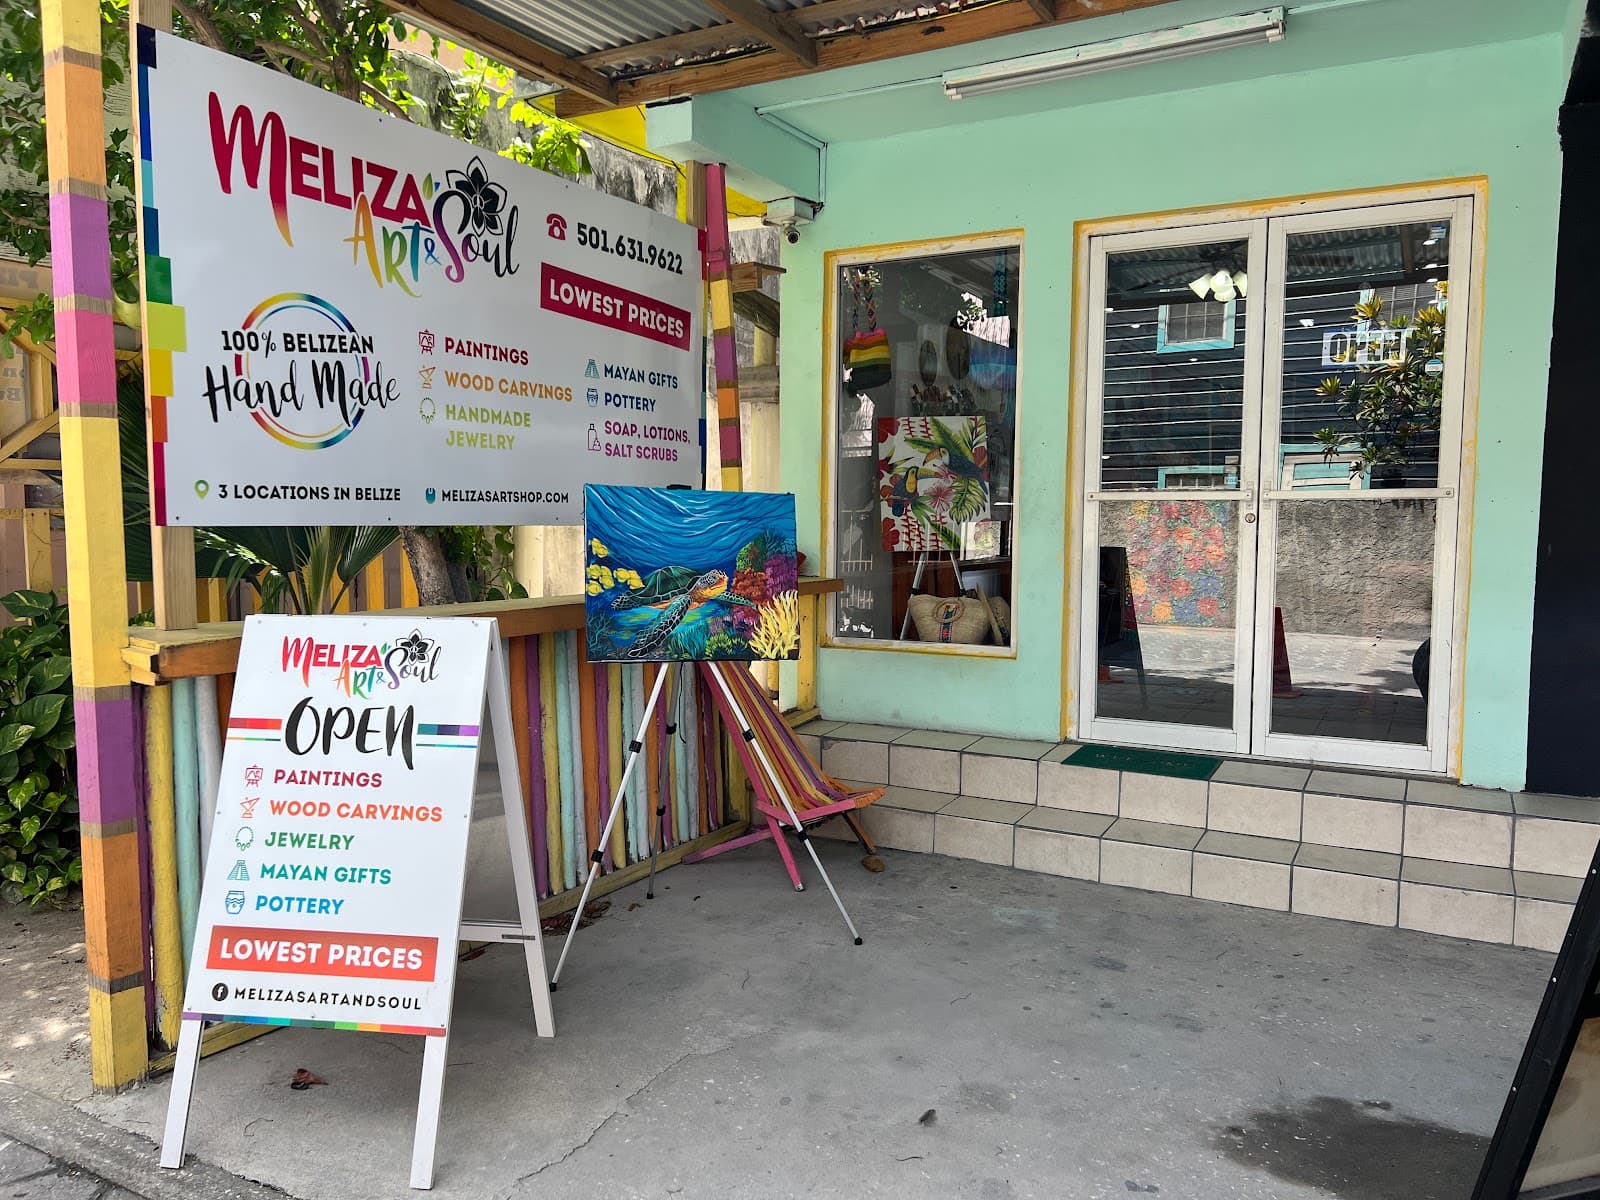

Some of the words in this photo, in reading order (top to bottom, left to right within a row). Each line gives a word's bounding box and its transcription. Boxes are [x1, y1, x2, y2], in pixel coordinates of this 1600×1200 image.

[577, 222, 683, 275] 501.631.9622
[550, 278, 623, 319] LOWEST
[628, 303, 684, 339] PRICES
[221, 330, 276, 358] 100%
[283, 332, 374, 353] BELIZEAN
[444, 336, 529, 366] PAINTINGS
[444, 370, 494, 392] WOOD
[500, 379, 573, 402] CARVINGS
[604, 363, 645, 383] MAYAN
[648, 371, 678, 389] GIFTS
[202, 359, 304, 423] Hand
[312, 359, 400, 428] Made
[604, 392, 656, 412] POTTERY
[445, 404, 531, 428] HANDMADE
[445, 430, 515, 450] JEWELRY
[604, 421, 641, 440] SOAP,
[644, 424, 691, 444] LOTIONS,
[604, 443, 632, 458] SALT
[636, 446, 678, 462] SCRUBS
[218, 484, 228, 499] 3
[234, 484, 330, 500] LOCATIONS
[334, 487, 350, 500] IN
[355, 487, 401, 501] BELIZE
[441, 489, 569, 504] MELIZASARTSHOP.COM
[285, 696, 415, 770] OPEN
[273, 769, 383, 788] PAINTINGS
[269, 799, 331, 818] WOOD
[336, 802, 443, 823] CARVINGS
[264, 831, 355, 850] JEWELRY
[260, 863, 328, 881] MAYAN
[334, 866, 392, 885] GIFTS
[255, 895, 344, 915] POTTERY
[220, 938, 321, 964] LOWEST
[328, 943, 423, 970] PRICES
[234, 987, 422, 1010] MELIZASARTANDSOUL
